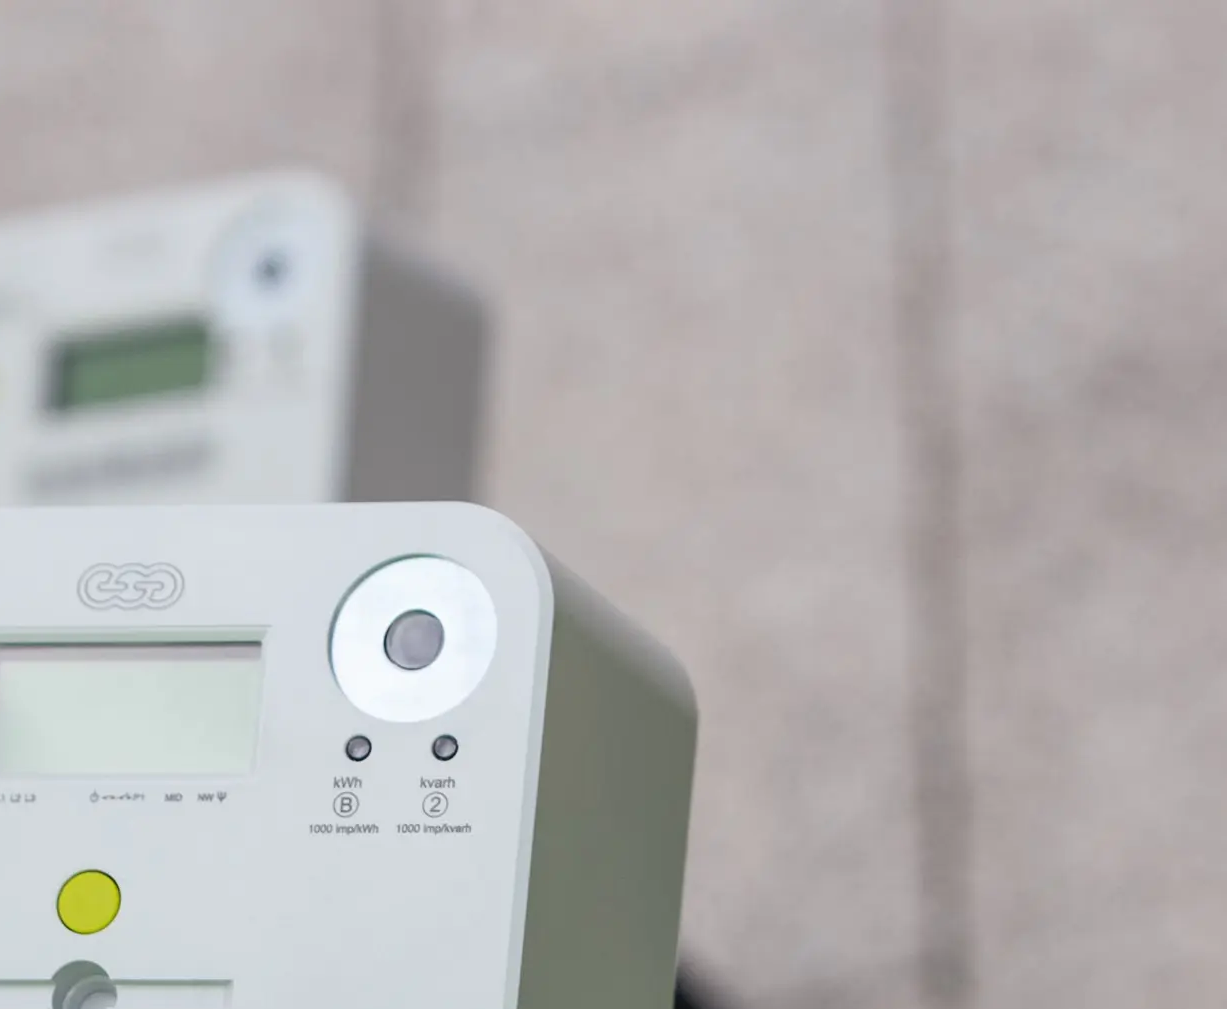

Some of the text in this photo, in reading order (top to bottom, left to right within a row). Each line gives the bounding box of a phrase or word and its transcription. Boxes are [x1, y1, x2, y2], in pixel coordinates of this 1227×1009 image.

[332, 776, 363, 789] kWh
[419, 776, 456, 789] kvarh
[309, 823, 380, 836] 1000 imp/kWh
[396, 822, 472, 836] 1000 imp/kvarh
